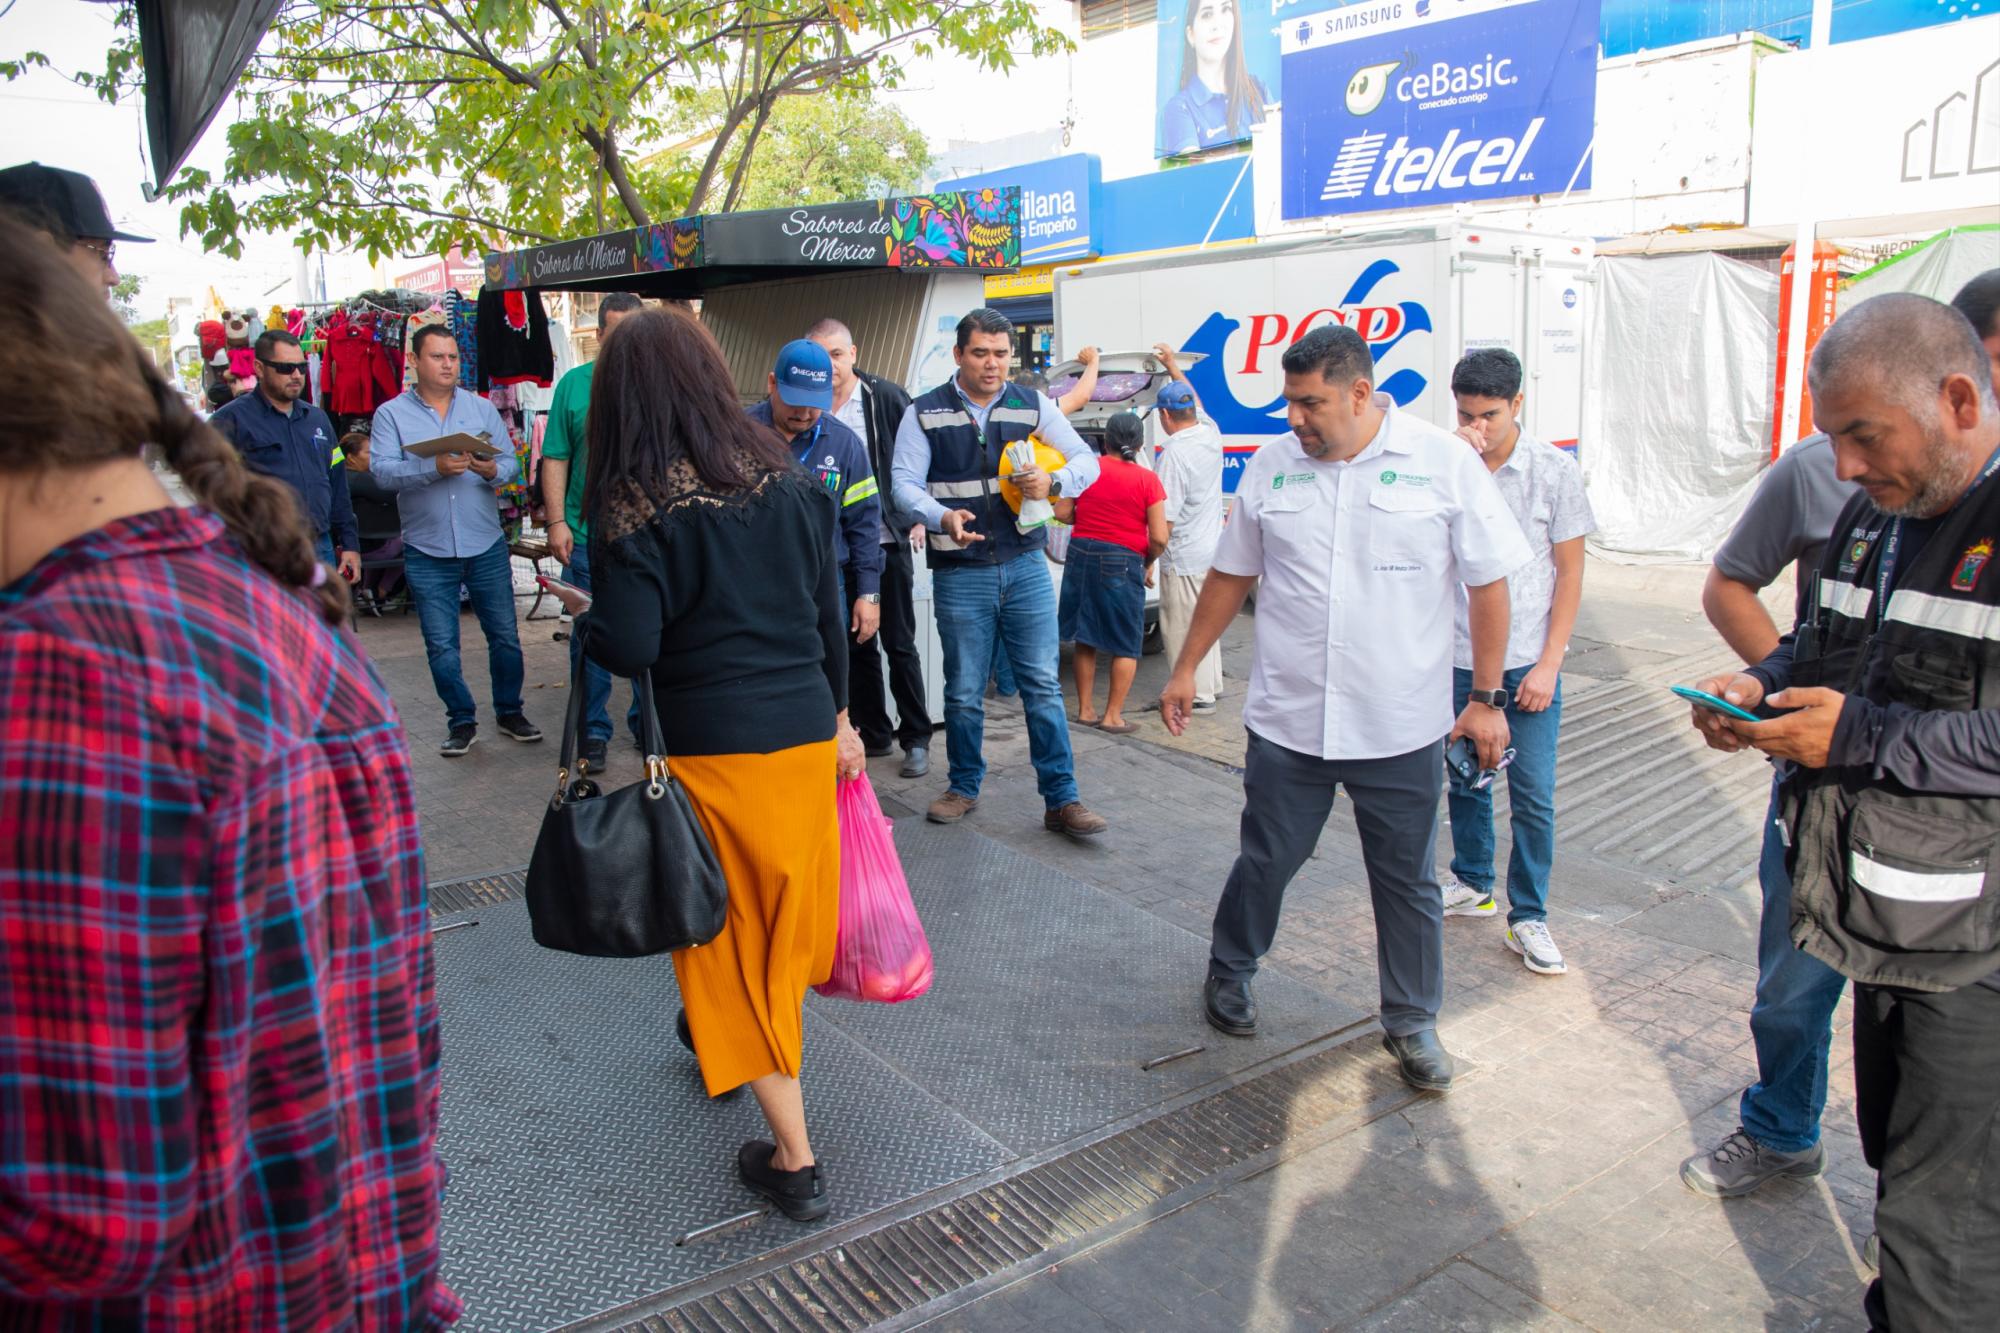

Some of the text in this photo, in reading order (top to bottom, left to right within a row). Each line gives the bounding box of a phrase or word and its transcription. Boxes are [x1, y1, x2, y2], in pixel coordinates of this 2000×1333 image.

[1325, 4, 1402, 34] SAMSUNG
[1396, 54, 1513, 102] ceBasic
[1418, 92, 1488, 110] conectado contigo
[1373, 117, 1545, 196] telcel
[782, 209, 891, 236] Sabores de
[1029, 216, 1077, 238] Empeño
[533, 240, 627, 279] Sabores de México
[801, 235, 876, 263] México
[1871, 240, 1925, 255] IMPO
